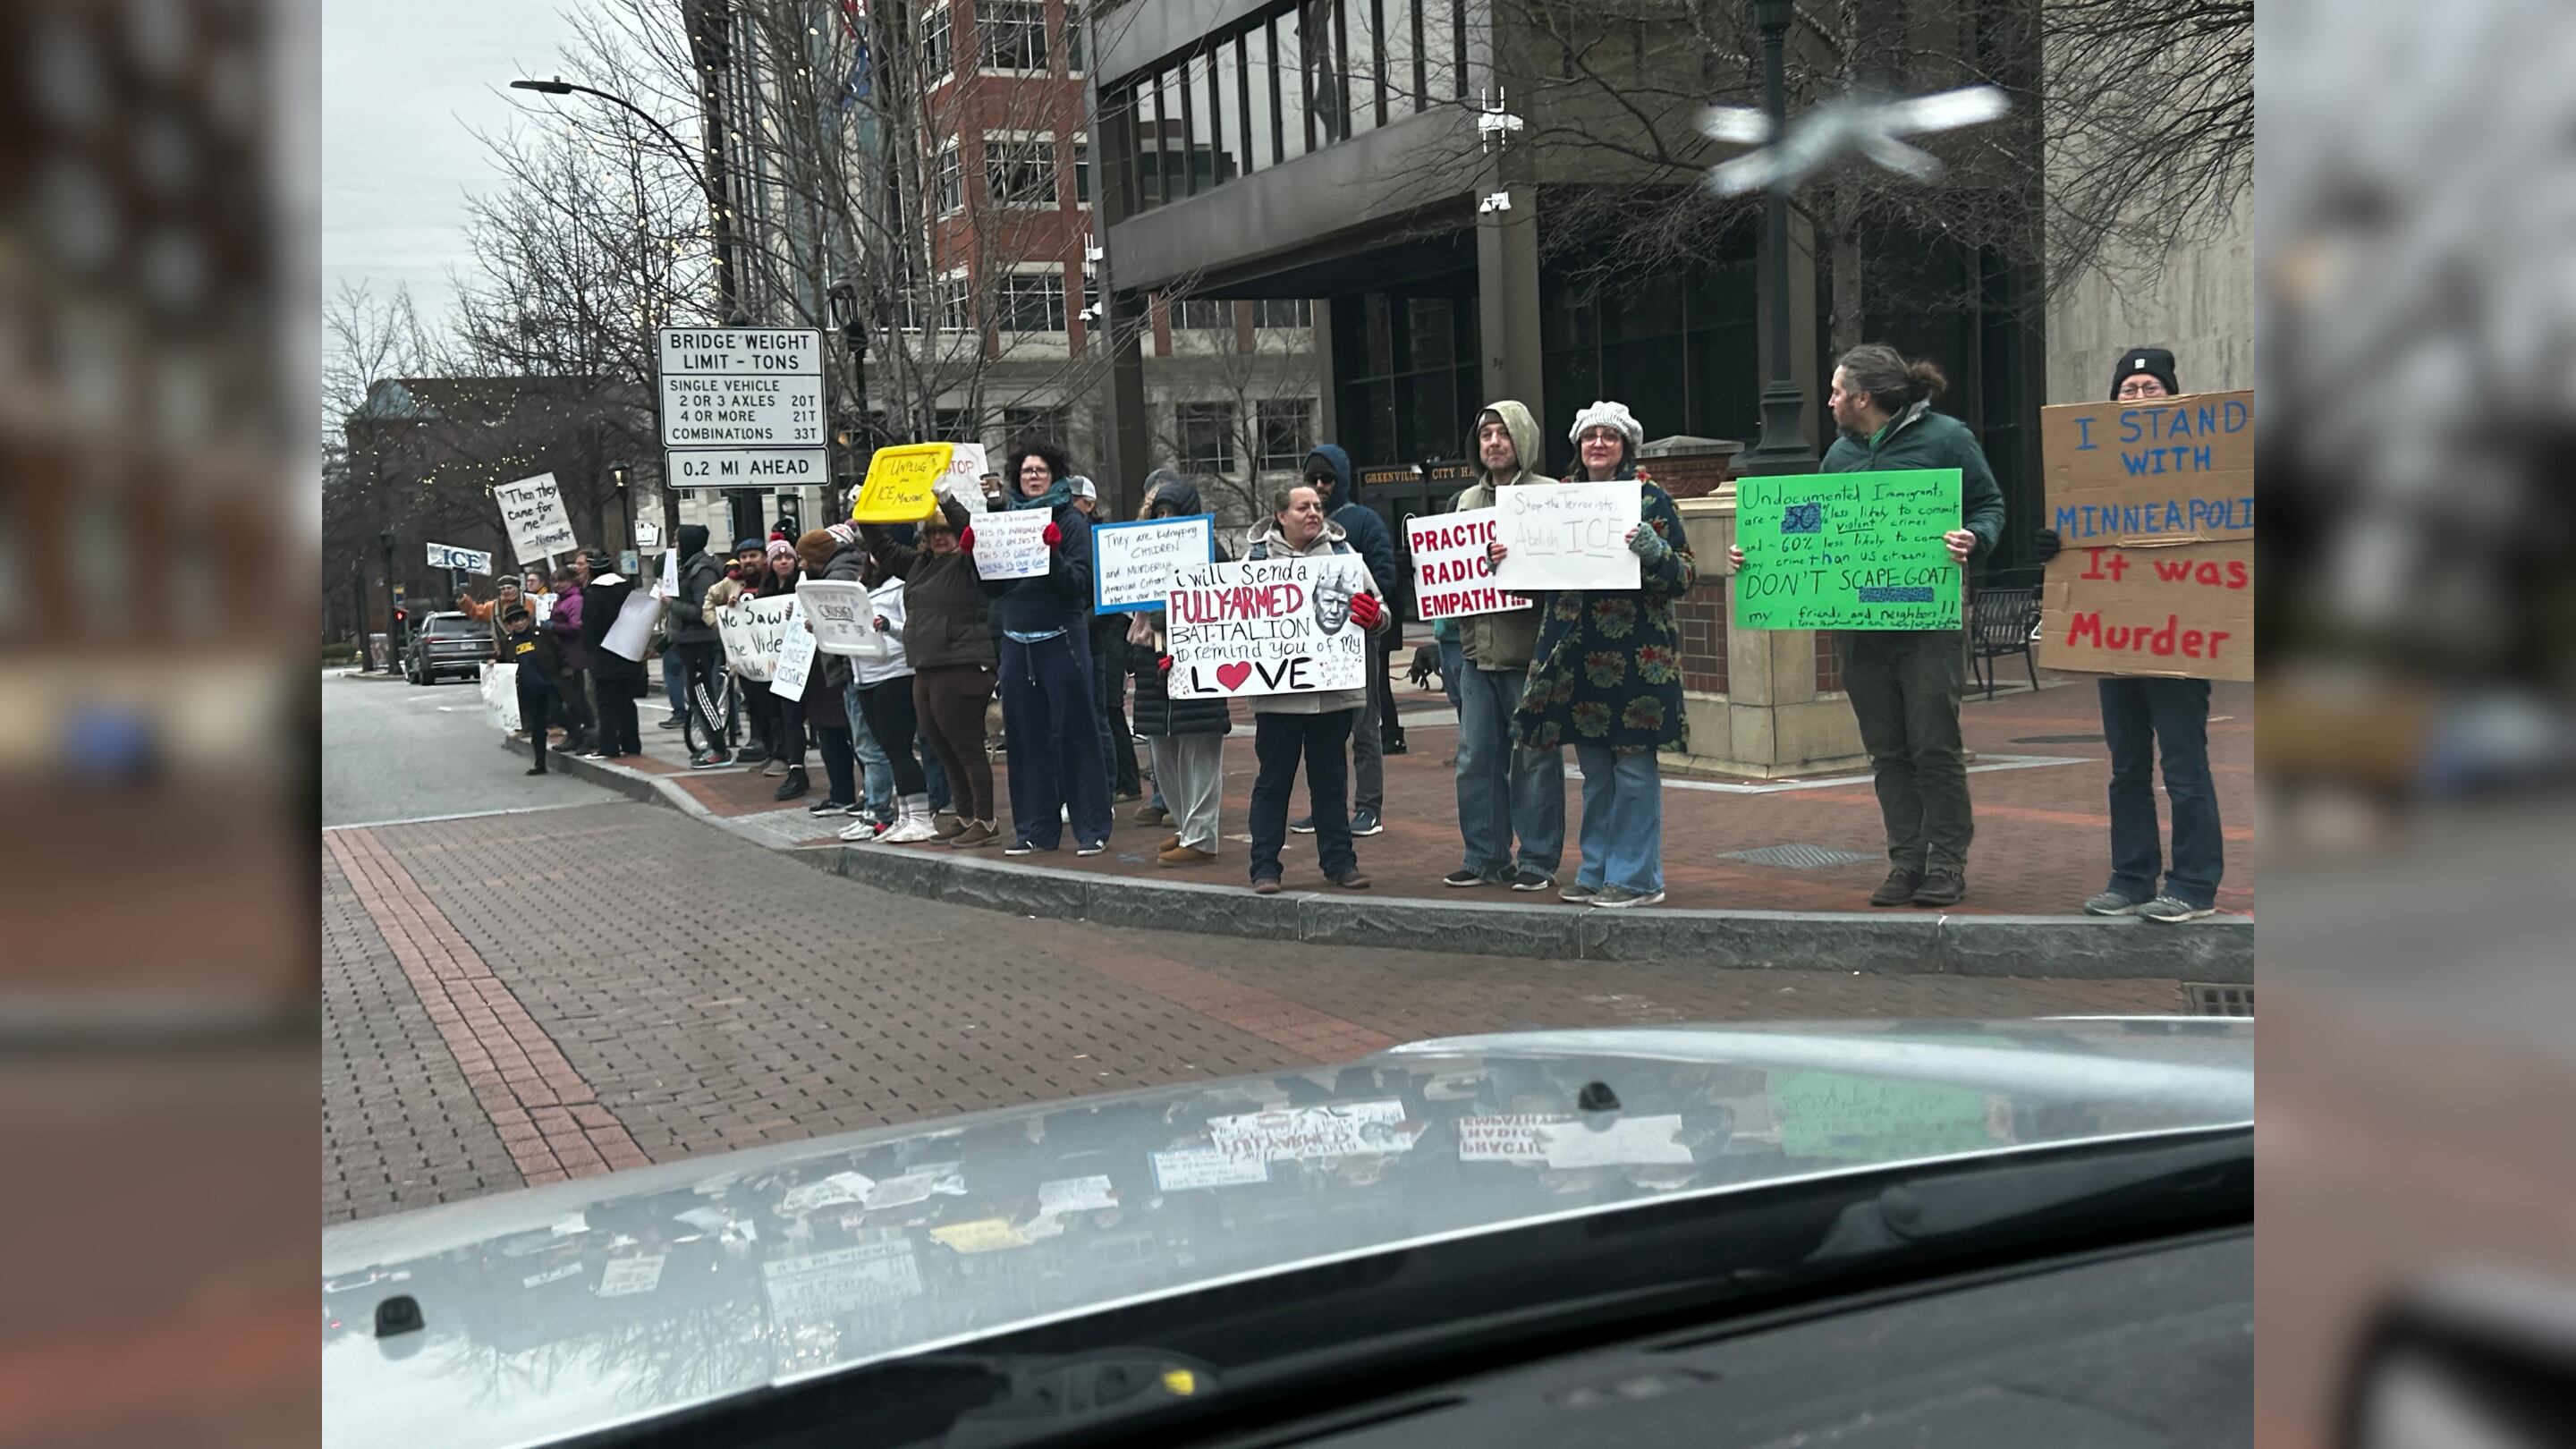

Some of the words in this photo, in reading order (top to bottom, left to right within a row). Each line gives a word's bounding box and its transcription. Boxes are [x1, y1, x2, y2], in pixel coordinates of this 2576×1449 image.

[671, 335, 735, 349] BRIDGE
[745, 335, 809, 350] WEIGHT
[684, 355, 728, 369] LIMIT
[753, 355, 799, 369] TONS
[670, 380, 717, 392] SINGLE
[724, 380, 780, 392] VEHICLE
[680, 395, 687, 407] 2
[694, 395, 711, 407] OR
[717, 395, 725, 407] 3
[732, 395, 775, 407] AXLES
[792, 395, 815, 407] 20T
[681, 411, 689, 421] 4
[695, 411, 712, 421] OR
[718, 411, 756, 421] MORE
[793, 411, 816, 422] 21T
[673, 428, 773, 439] COMBINATIONS
[794, 428, 817, 439] 33T
[2073, 418, 2098, 451] I
[2118, 401, 2248, 444] STAND
[683, 462, 709, 476] 0.2
[721, 462, 739, 475] MI
[750, 460, 809, 474] AHEAD
[2121, 444, 2211, 476] WITH
[1365, 471, 1419, 483] GREENVILLE
[1432, 467, 1455, 479] CITY
[536, 482, 556, 498] they
[877, 487, 895, 500] ICE
[1741, 484, 1860, 510] Undocumented
[1872, 482, 1944, 502] Immigrants
[508, 509, 533, 520] came
[537, 502, 554, 513] for
[1514, 492, 1542, 515] Stop
[1545, 499, 1559, 509] the
[1744, 515, 1764, 527] are
[1831, 509, 1849, 519] less
[1860, 502, 1889, 523] likely
[1898, 504, 1912, 516] to
[1918, 504, 1960, 515] commit
[2055, 497, 2254, 539] MINNEAPOLI
[1837, 520, 1876, 531] violent
[1105, 533, 1130, 550] They
[1137, 534, 1152, 542] are
[1513, 522, 1560, 551] Abolish
[1563, 518, 1625, 554] ICE
[1744, 539, 1763, 553] and
[1781, 537, 1813, 554] 60%
[1824, 538, 1844, 548] less
[1854, 533, 1885, 547] likely
[1895, 533, 1909, 543] to
[1131, 540, 1179, 558] CHILDREN
[443, 549, 482, 569] ICE
[1775, 557, 1804, 567] crime
[1809, 551, 1851, 565] than
[1860, 552, 1876, 562] US
[2080, 547, 2130, 582] It
[2153, 559, 2250, 589] was
[1106, 567, 1119, 579] and
[1174, 569, 1186, 588] i
[1188, 565, 1225, 587] will
[1745, 570, 1827, 600] DON'T
[1838, 567, 1953, 590] SCAPEGOAT
[719, 609, 737, 629] We
[745, 606, 781, 625] Saw
[1749, 612, 1773, 623] my
[1798, 606, 1842, 619] friends
[1850, 609, 1872, 620] and
[1170, 617, 1309, 644] BATTALION
[2066, 611, 2231, 659] Murder
[1175, 648, 1189, 662] to
[1195, 641, 1262, 659] remind
[1269, 640, 1308, 659] you
[1317, 639, 1334, 652] of
